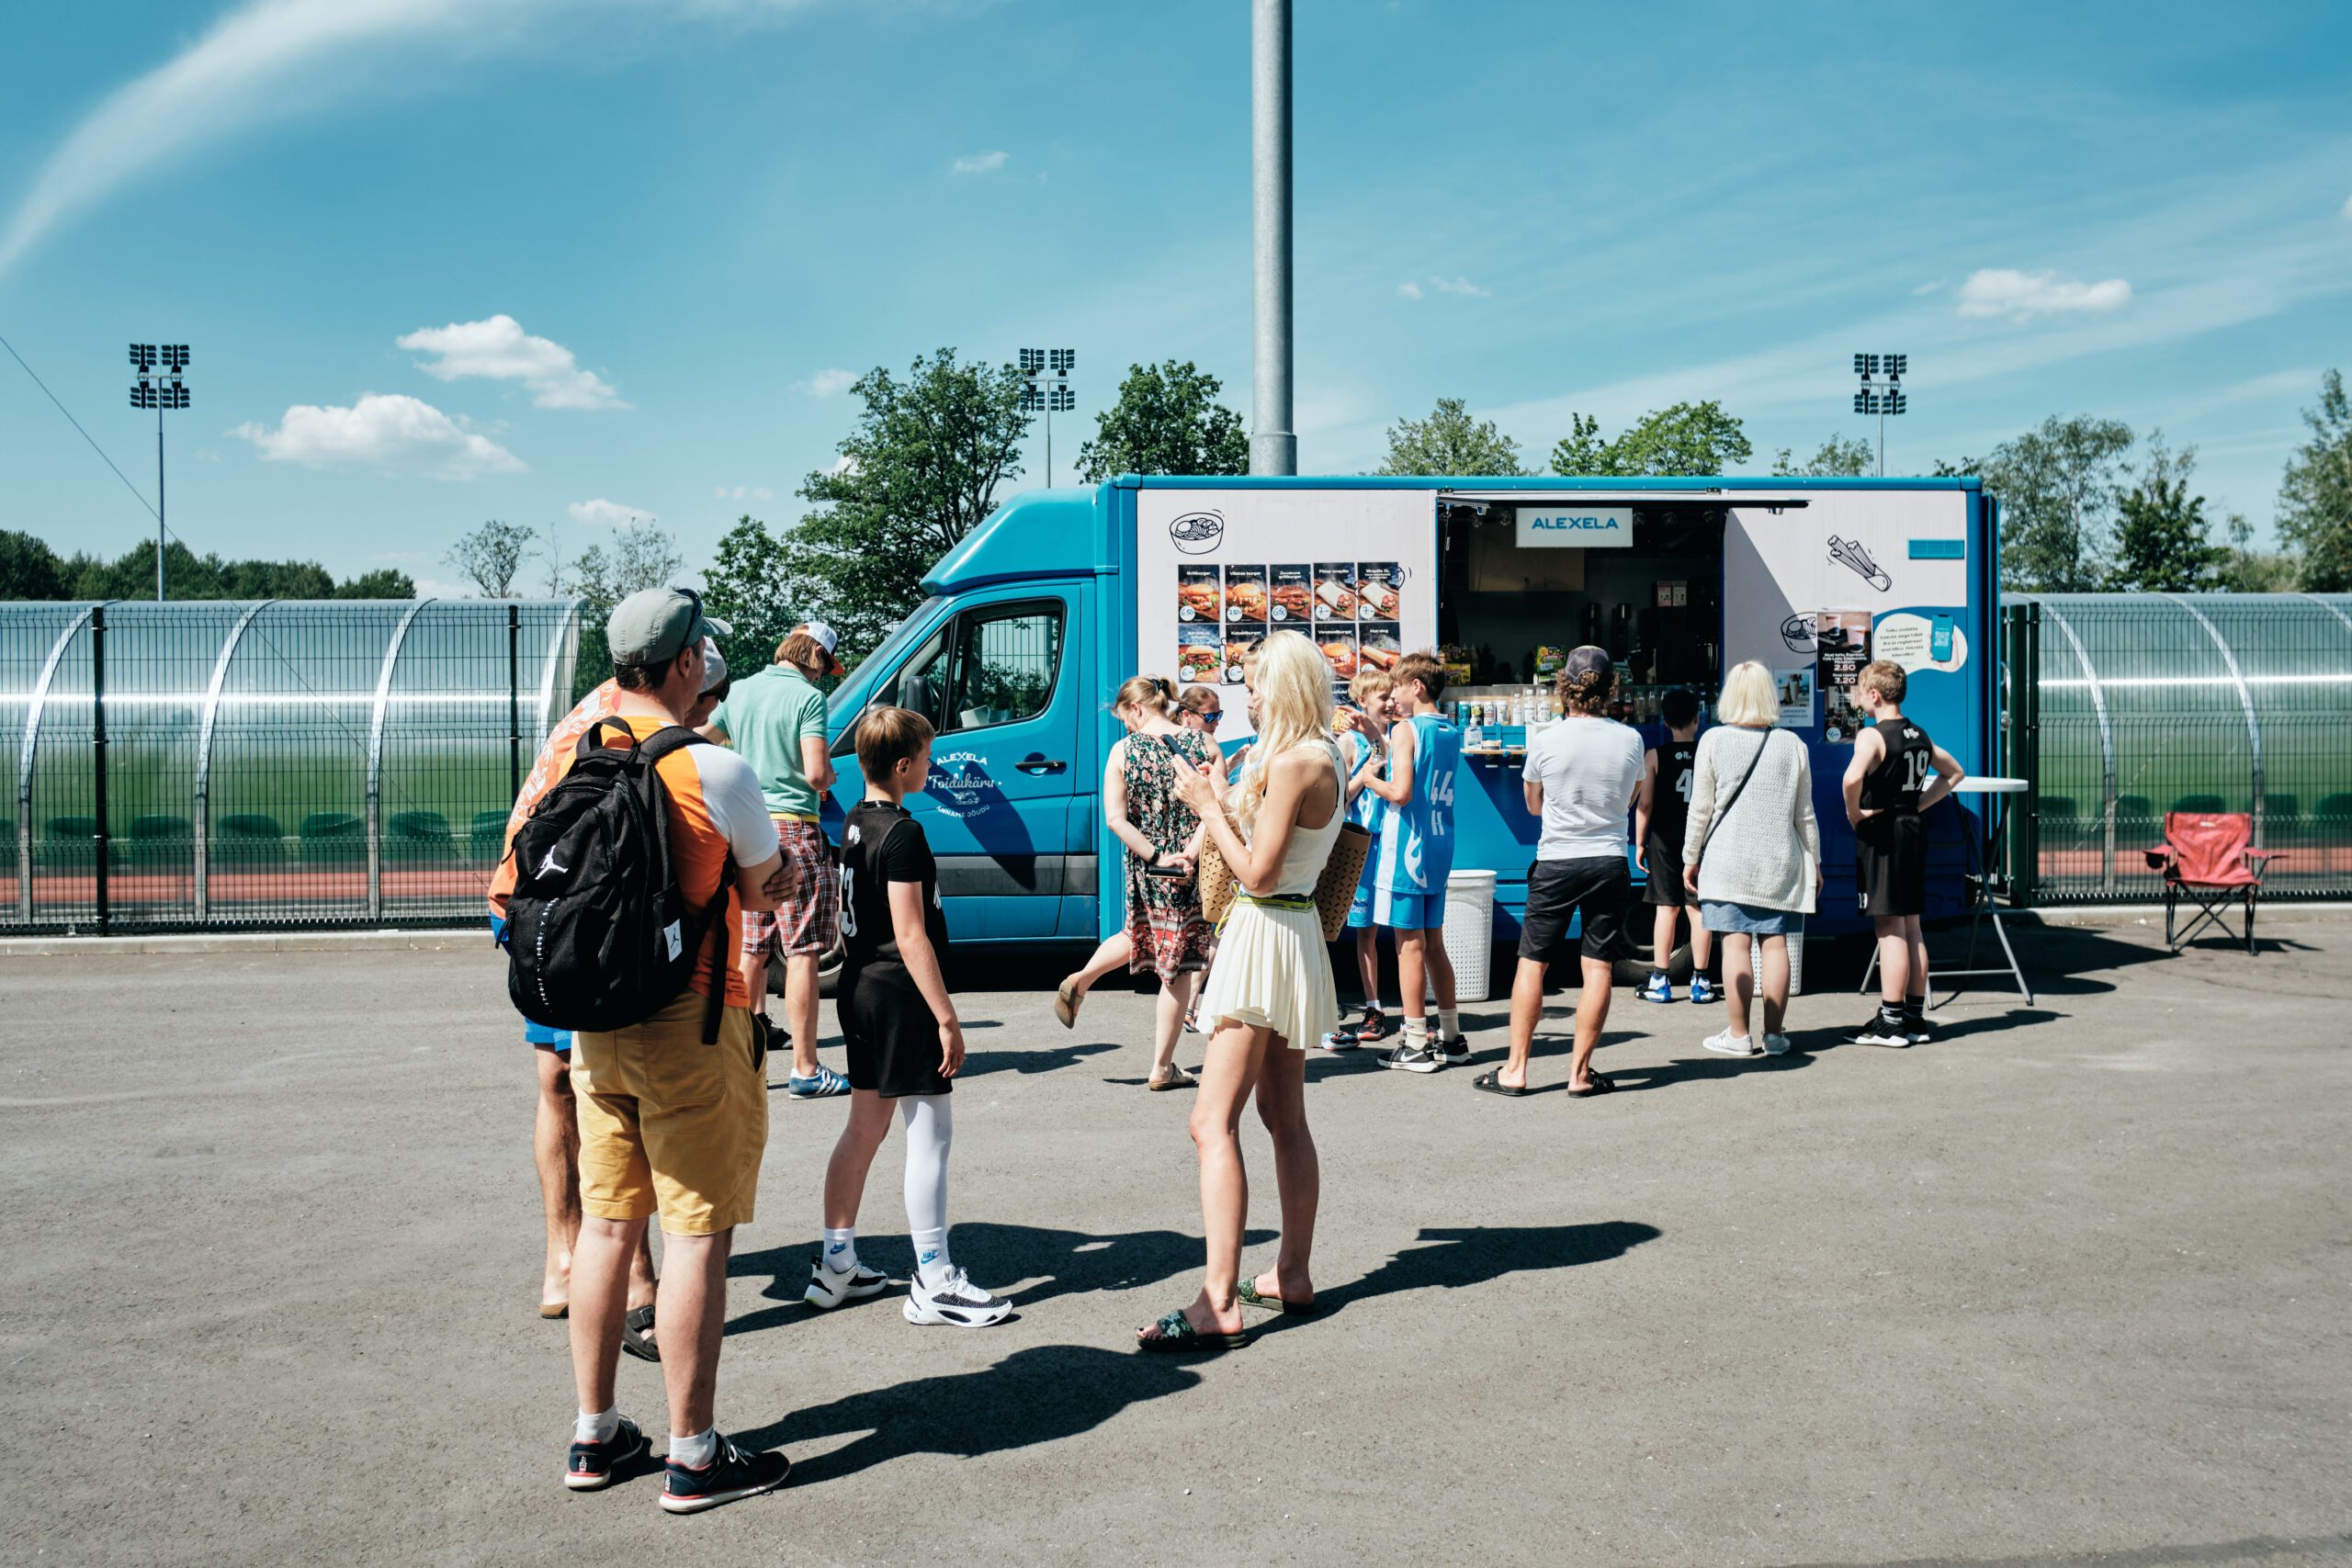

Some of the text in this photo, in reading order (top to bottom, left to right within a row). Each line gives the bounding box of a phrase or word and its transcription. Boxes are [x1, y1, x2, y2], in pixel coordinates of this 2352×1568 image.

[1532, 517, 1619, 529] ALEXELA
[936, 751, 988, 766] ALEXELA
[1902, 750, 1929, 792] 19
[928, 773, 995, 789] Toidukäru
[1430, 769, 1453, 807] 44
[936, 804, 990, 818] ANNAME JÕUDU
